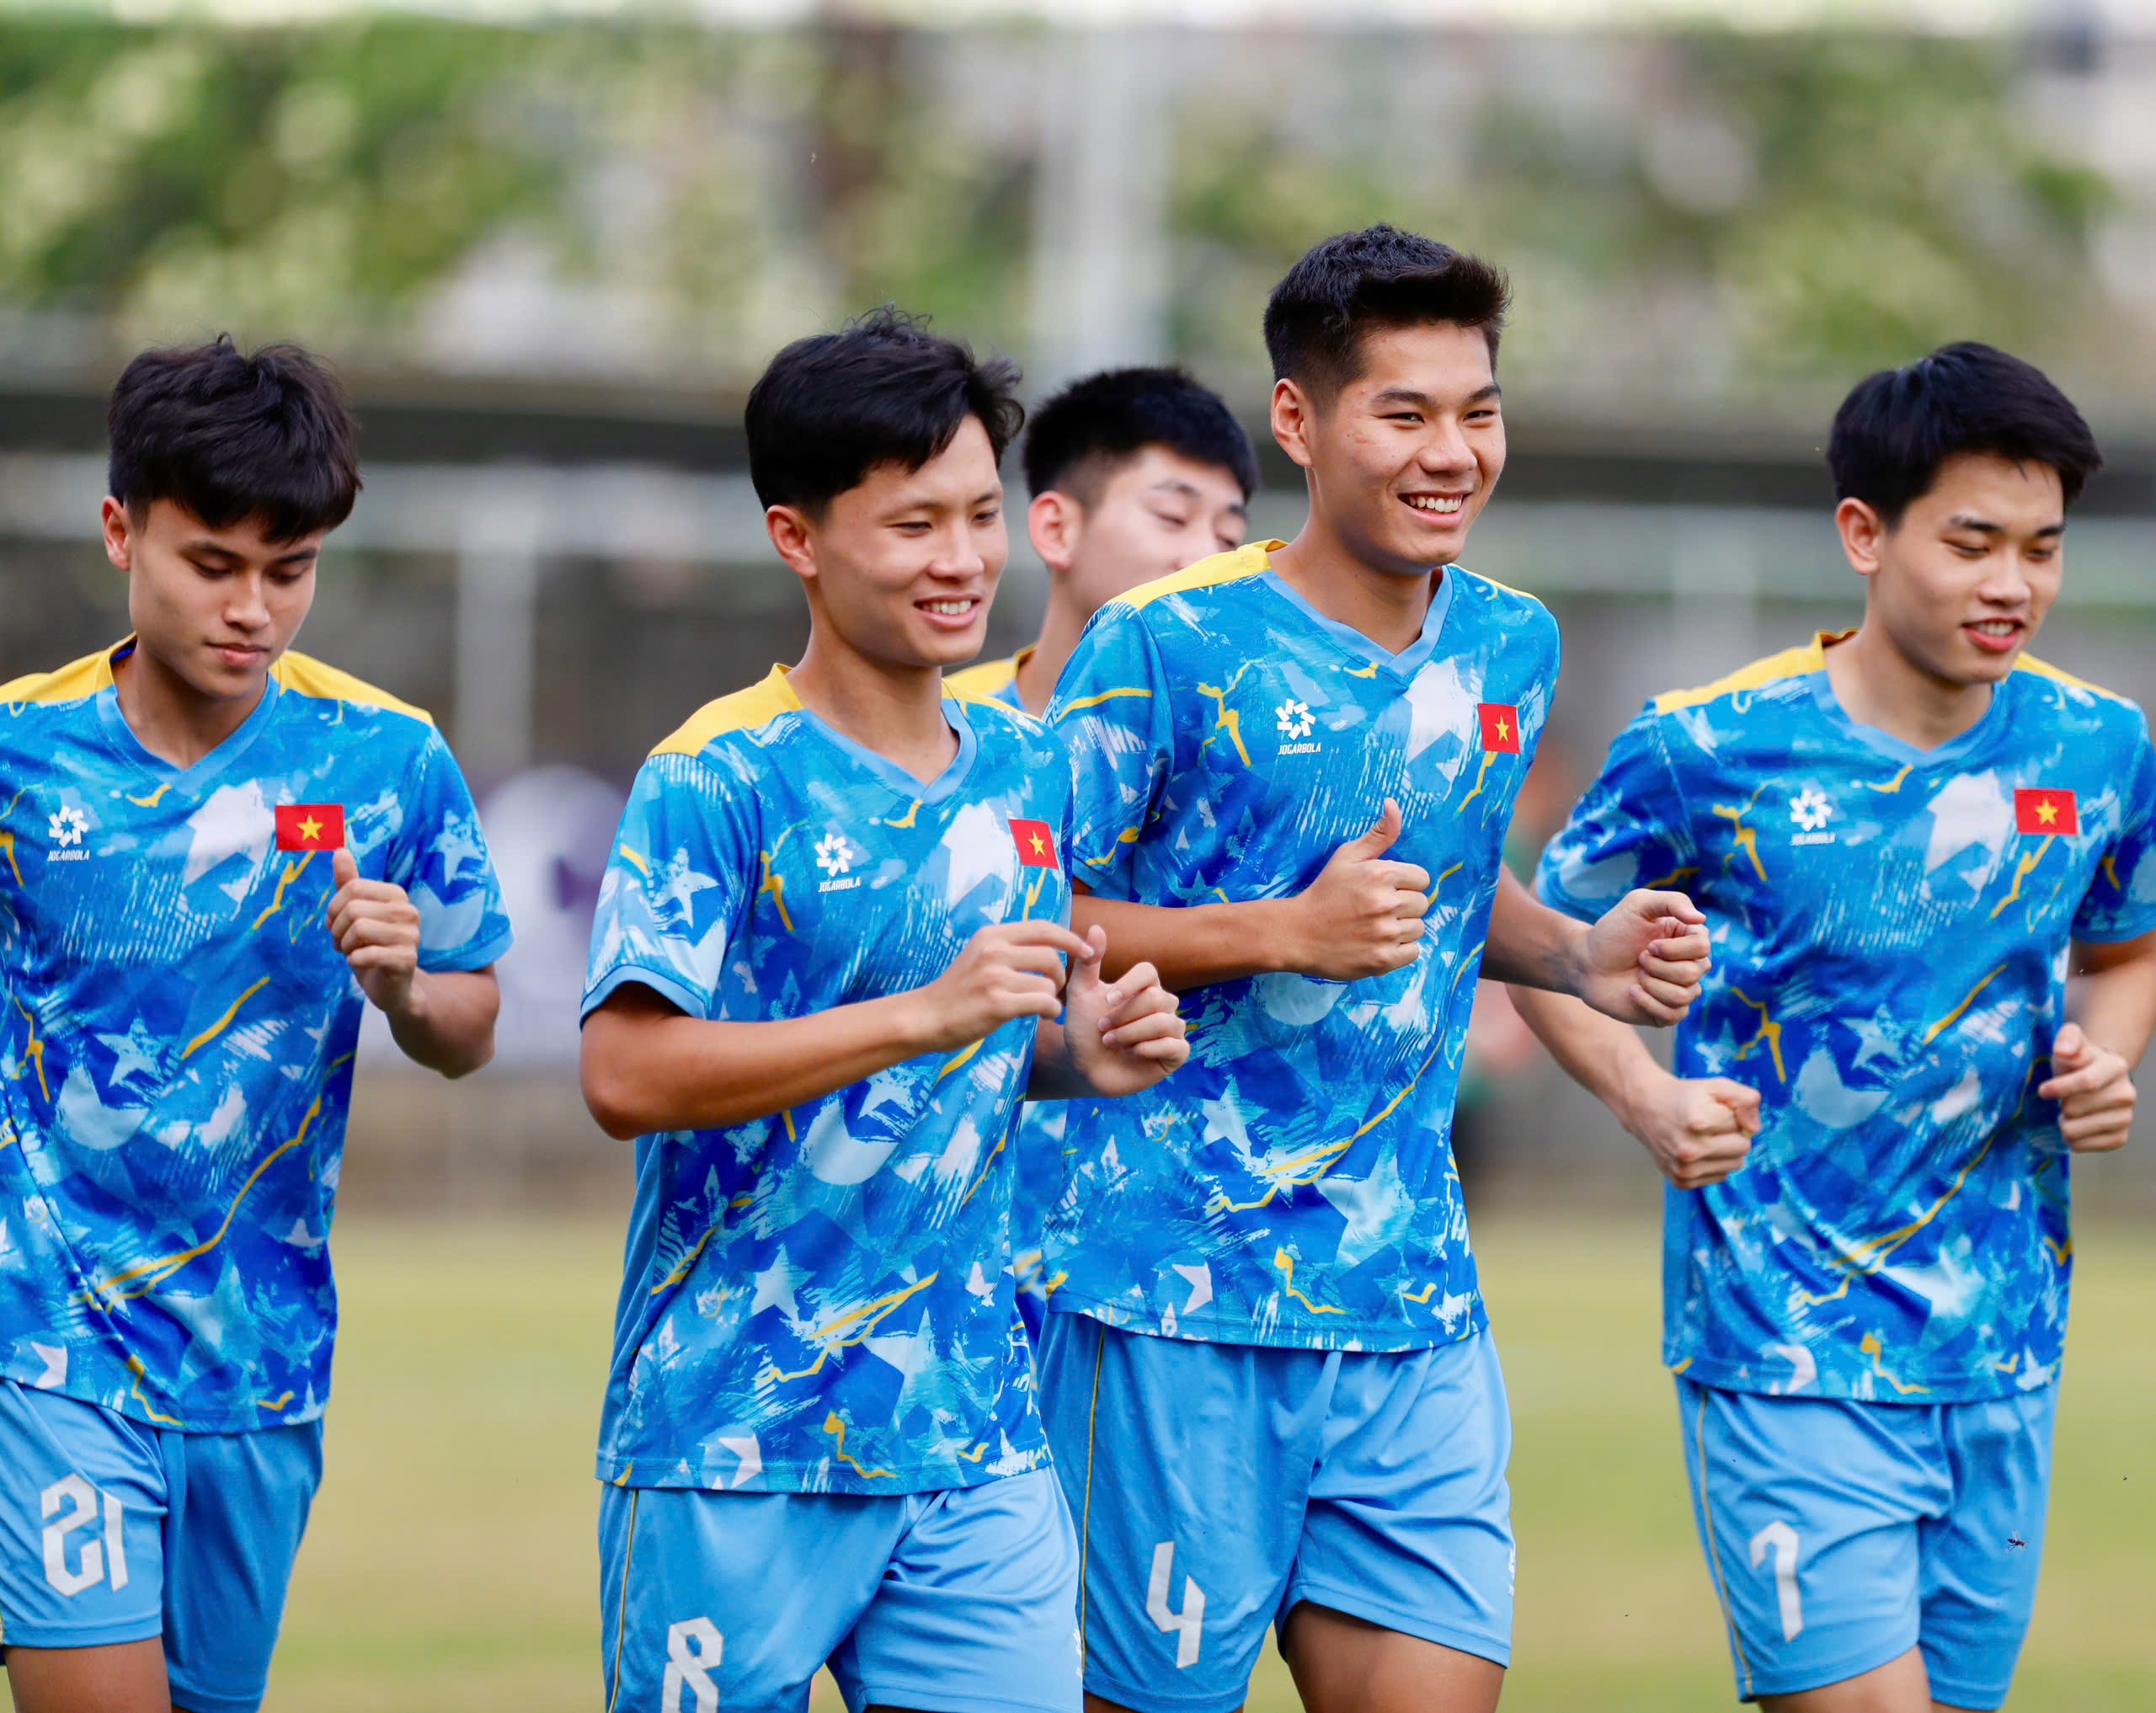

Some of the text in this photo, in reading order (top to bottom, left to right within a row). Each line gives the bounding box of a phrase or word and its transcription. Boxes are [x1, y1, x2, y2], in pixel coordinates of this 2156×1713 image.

[1278, 742, 1321, 755] JOGARBOLA
[818, 877, 861, 893] JOGARBOLA
[40, 1473, 129, 1598] 21
[1749, 1520, 1804, 1642] 7
[1146, 1540, 1206, 1669] 4
[662, 1616, 724, 1713] 8
